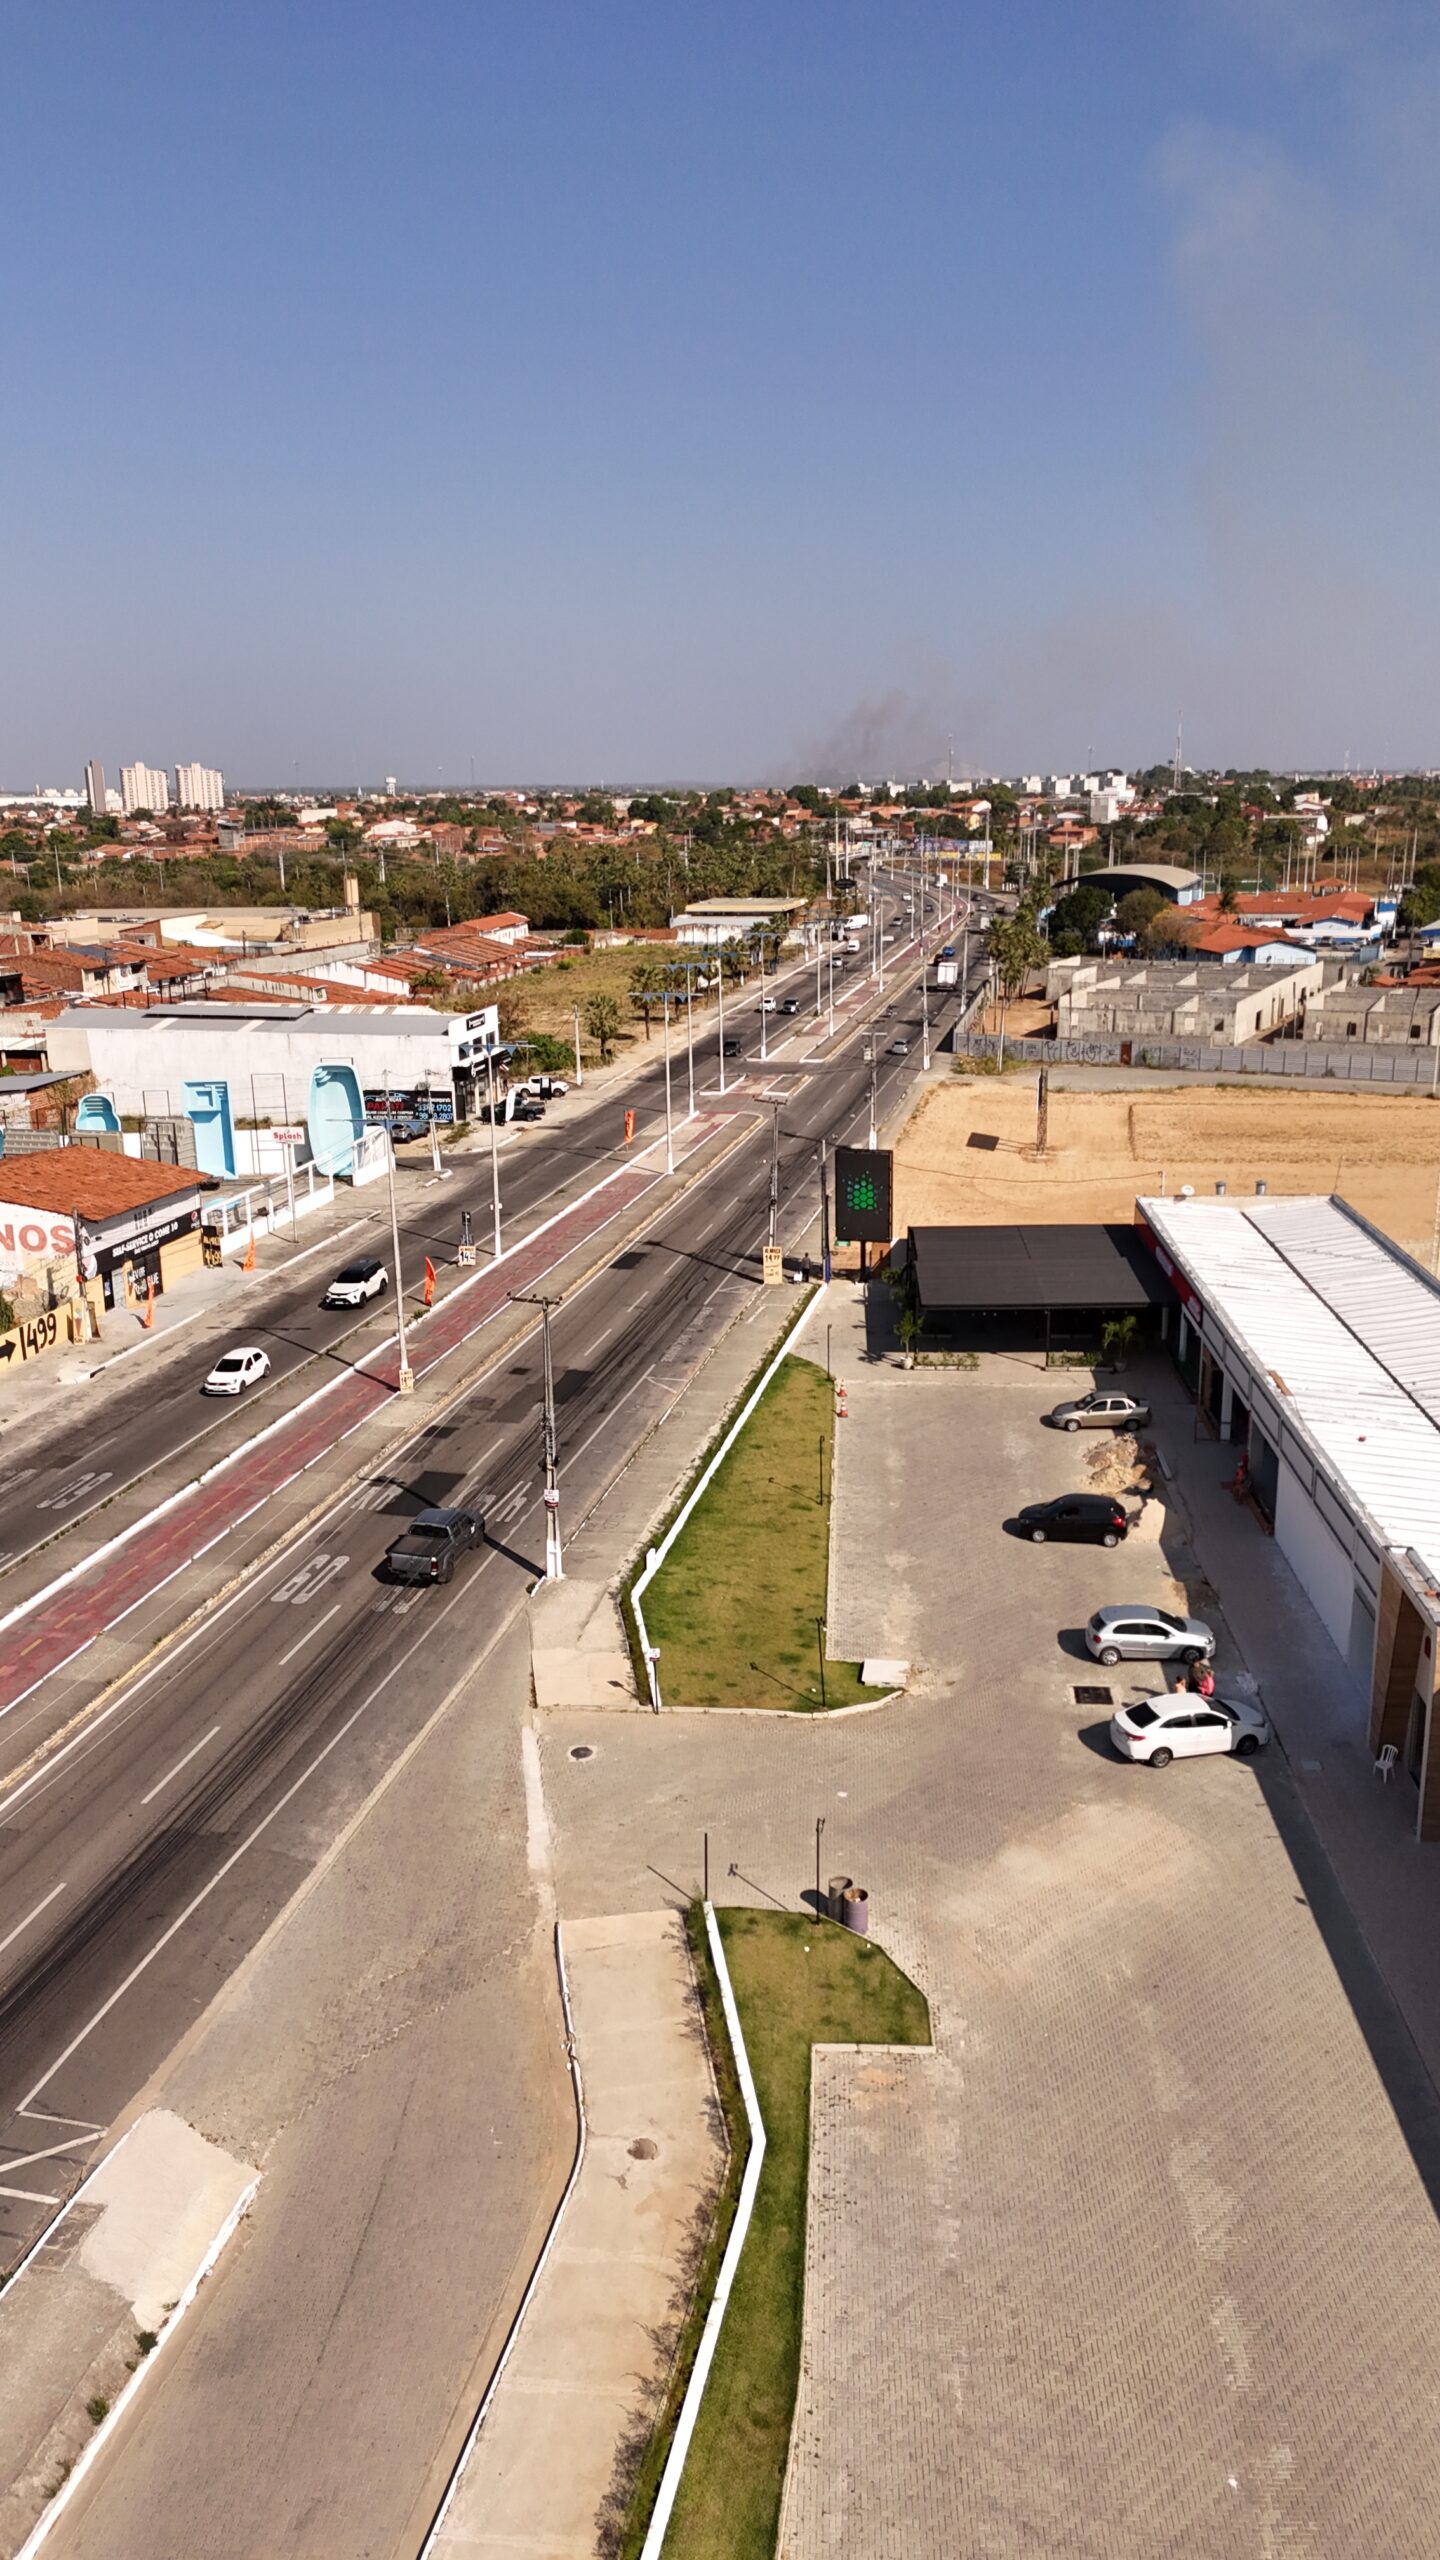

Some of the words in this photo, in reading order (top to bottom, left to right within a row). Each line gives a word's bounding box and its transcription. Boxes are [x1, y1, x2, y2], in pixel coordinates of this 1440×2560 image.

[273, 1131, 302, 1141] Splash
[112, 1234, 148, 1258] SELF-SERVICE
[154, 1224, 170, 1239] COME
[270, 1554, 350, 1604] 60
